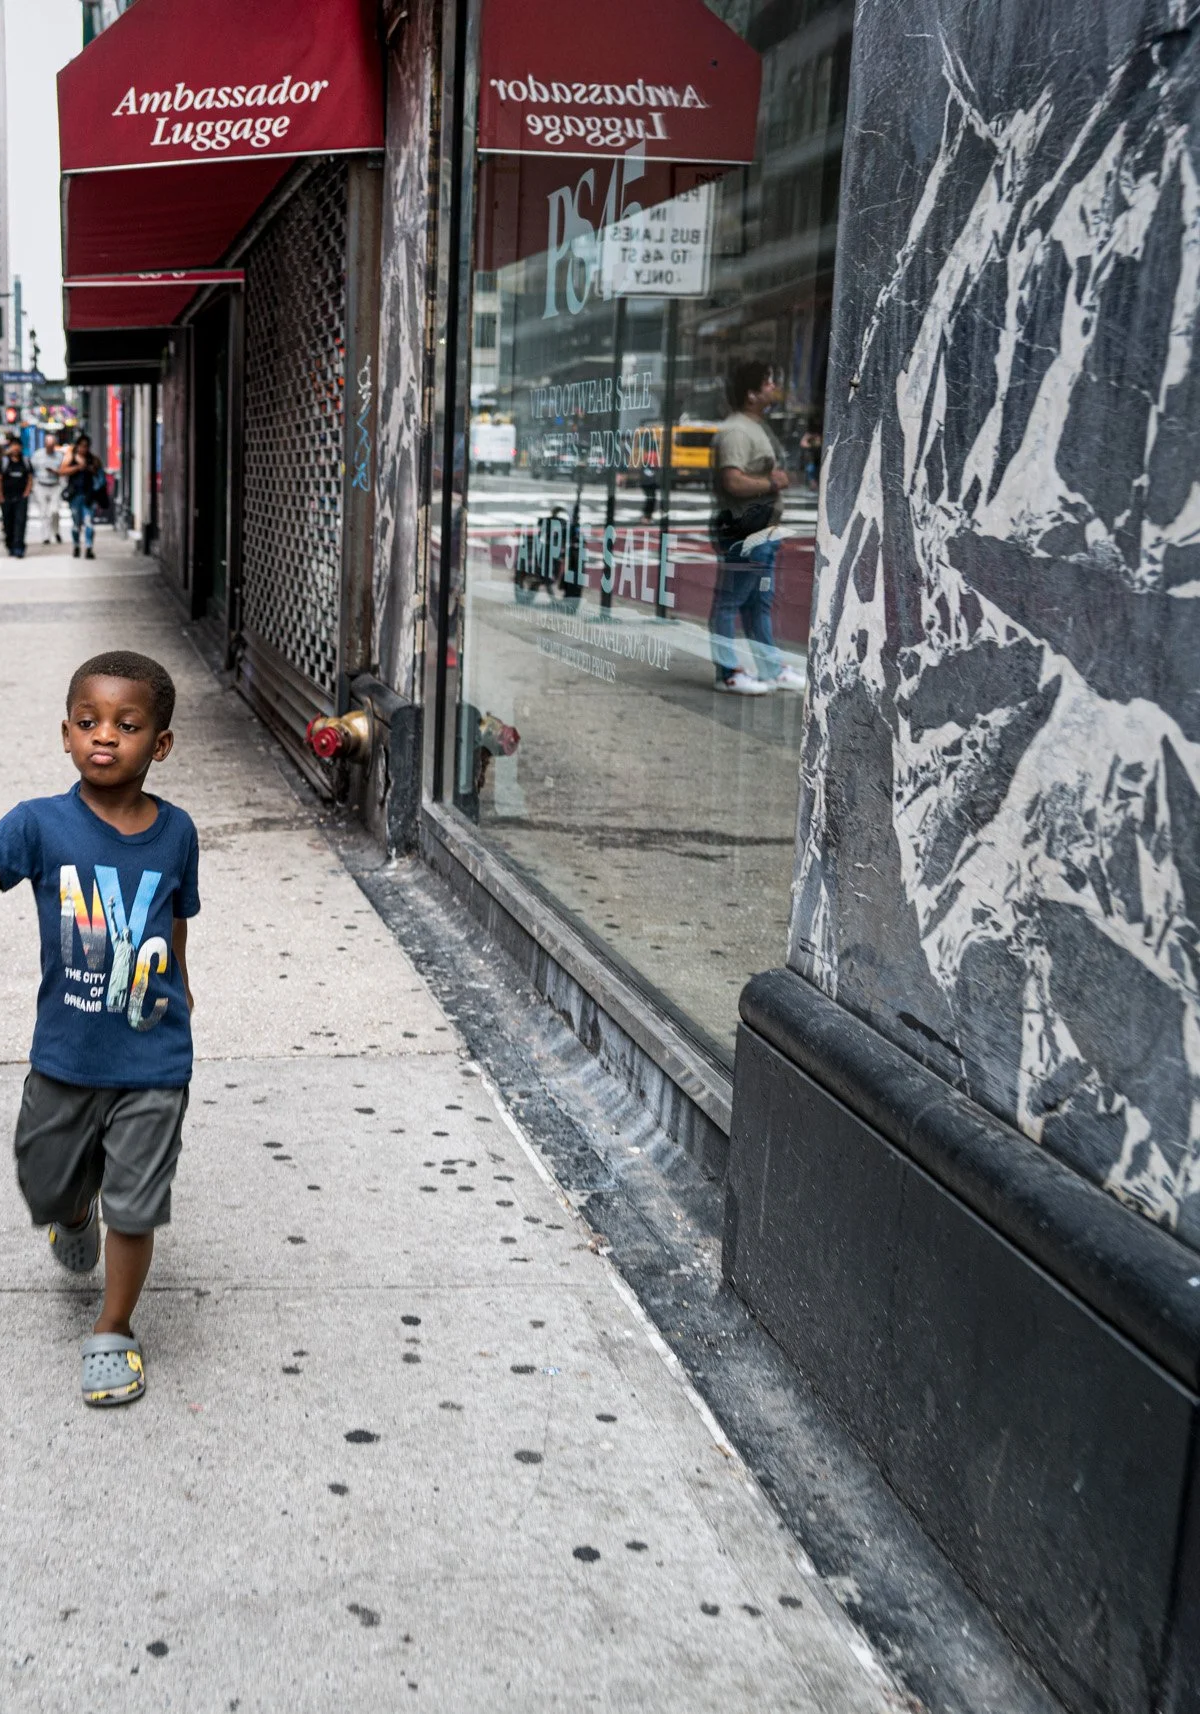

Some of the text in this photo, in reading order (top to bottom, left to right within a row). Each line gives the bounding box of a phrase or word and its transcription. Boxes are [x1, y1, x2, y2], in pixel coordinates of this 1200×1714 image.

[112, 75, 329, 117] Ambassador
[150, 115, 290, 152] Luggage
[548, 377, 613, 418] FOOTWEAR
[615, 371, 652, 412] SALE
[588, 429, 622, 469] ENDS
[622, 427, 665, 469] SOON
[504, 517, 678, 608] SAMPLE SALE
[647, 634, 672, 671] OFF
[60, 864, 169, 1033] NYC
[65, 966, 106, 985] THE CITY
[90, 986, 104, 998] OF
[64, 992, 102, 1013] DREAMS
